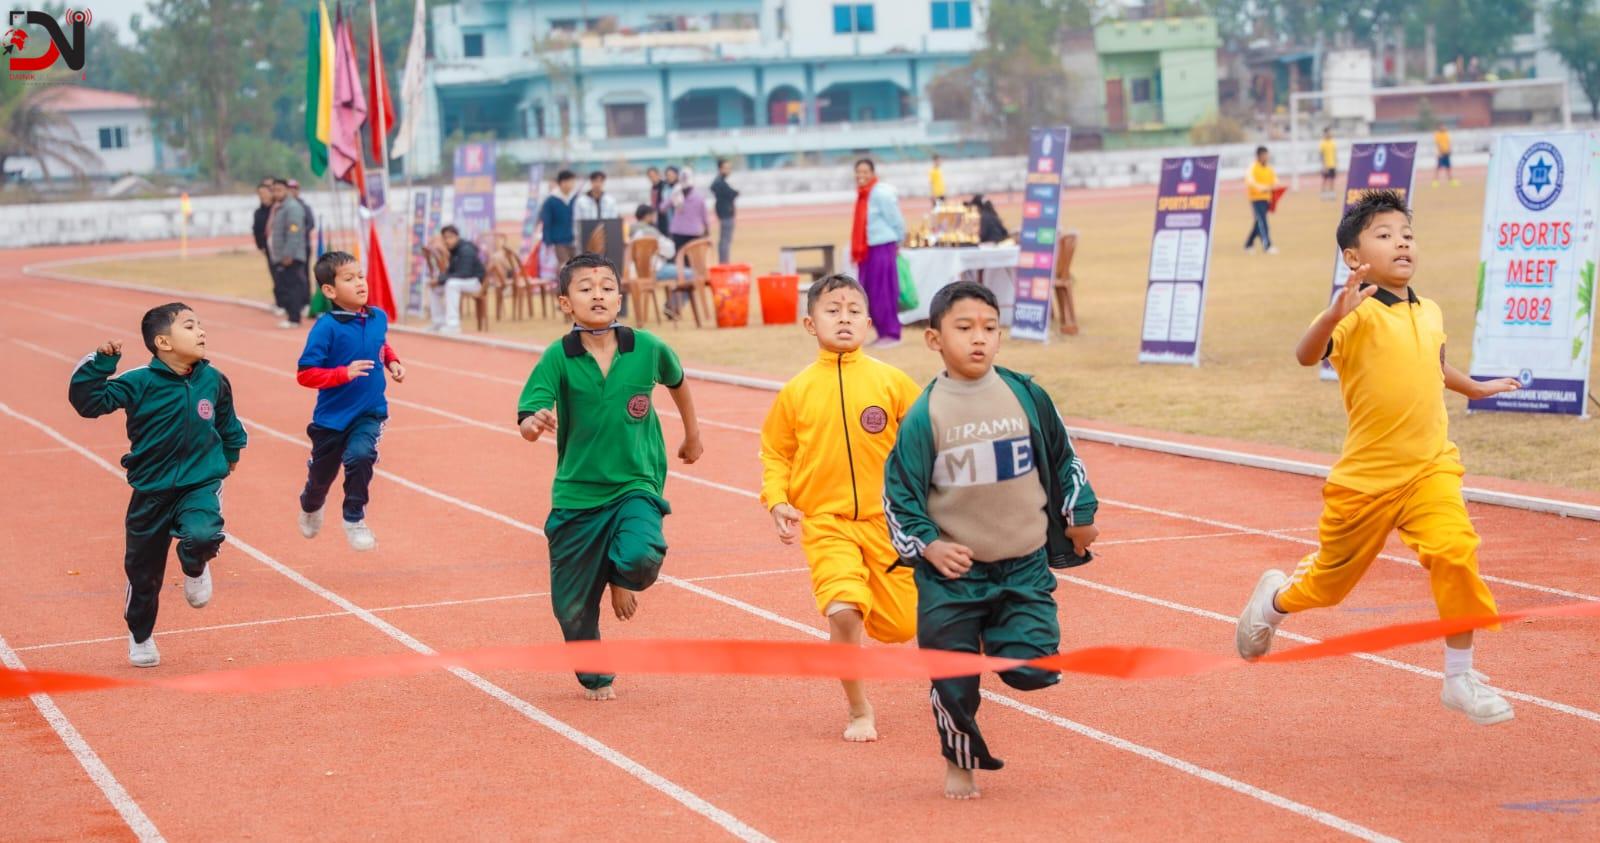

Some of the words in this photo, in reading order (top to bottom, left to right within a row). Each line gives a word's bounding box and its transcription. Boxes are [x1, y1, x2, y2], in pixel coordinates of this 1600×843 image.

[1498, 221, 1573, 248] SPORTS
[1506, 258, 1557, 286] MEET
[1504, 296, 1552, 325] 2082
